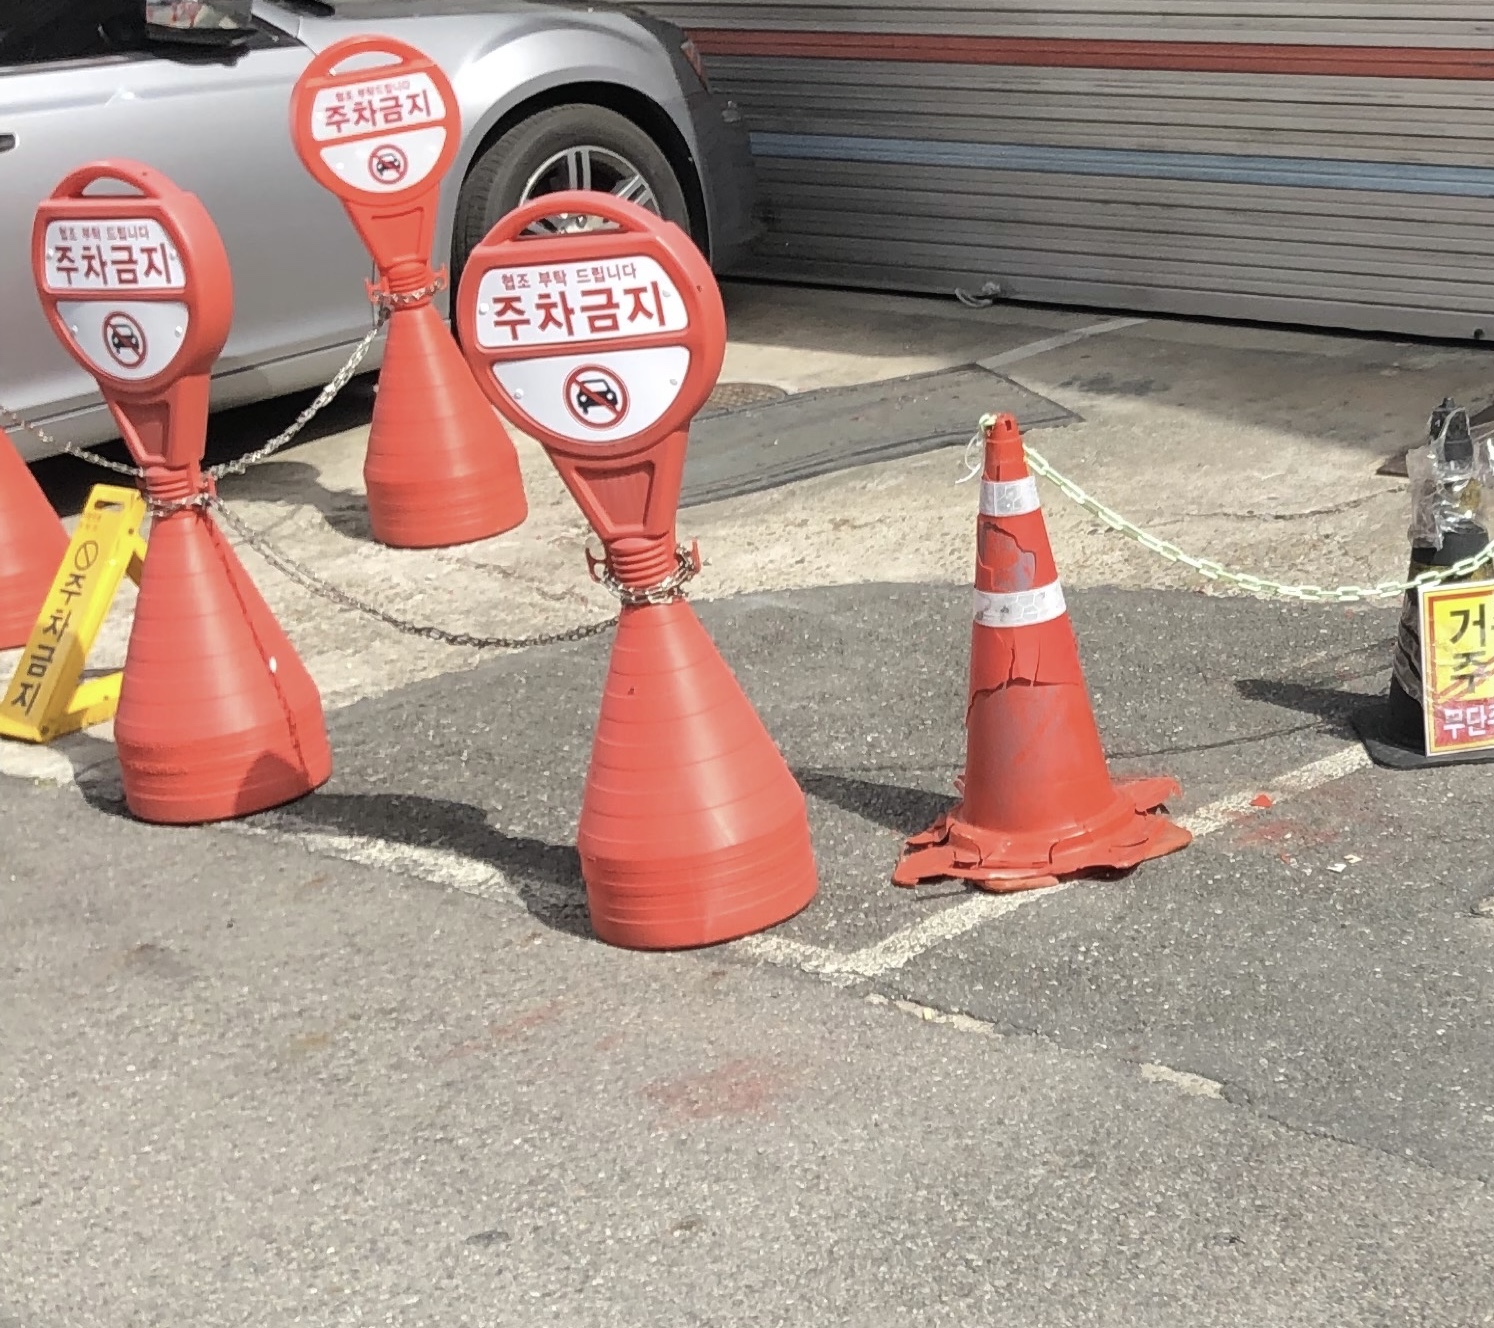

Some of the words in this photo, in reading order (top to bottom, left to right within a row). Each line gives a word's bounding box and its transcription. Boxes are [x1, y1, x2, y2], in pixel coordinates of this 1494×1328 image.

[324, 89, 431, 133] 주차금지
[58, 225, 77, 241] 협조
[106, 224, 150, 240] 드립니다
[54, 242, 172, 286] 주차금지
[501, 273, 531, 291] 협조
[537, 269, 568, 288] 부탁
[575, 263, 637, 284] 드립니다
[492, 280, 666, 341] 주차금지
[11, 573, 86, 717] 주차금지
